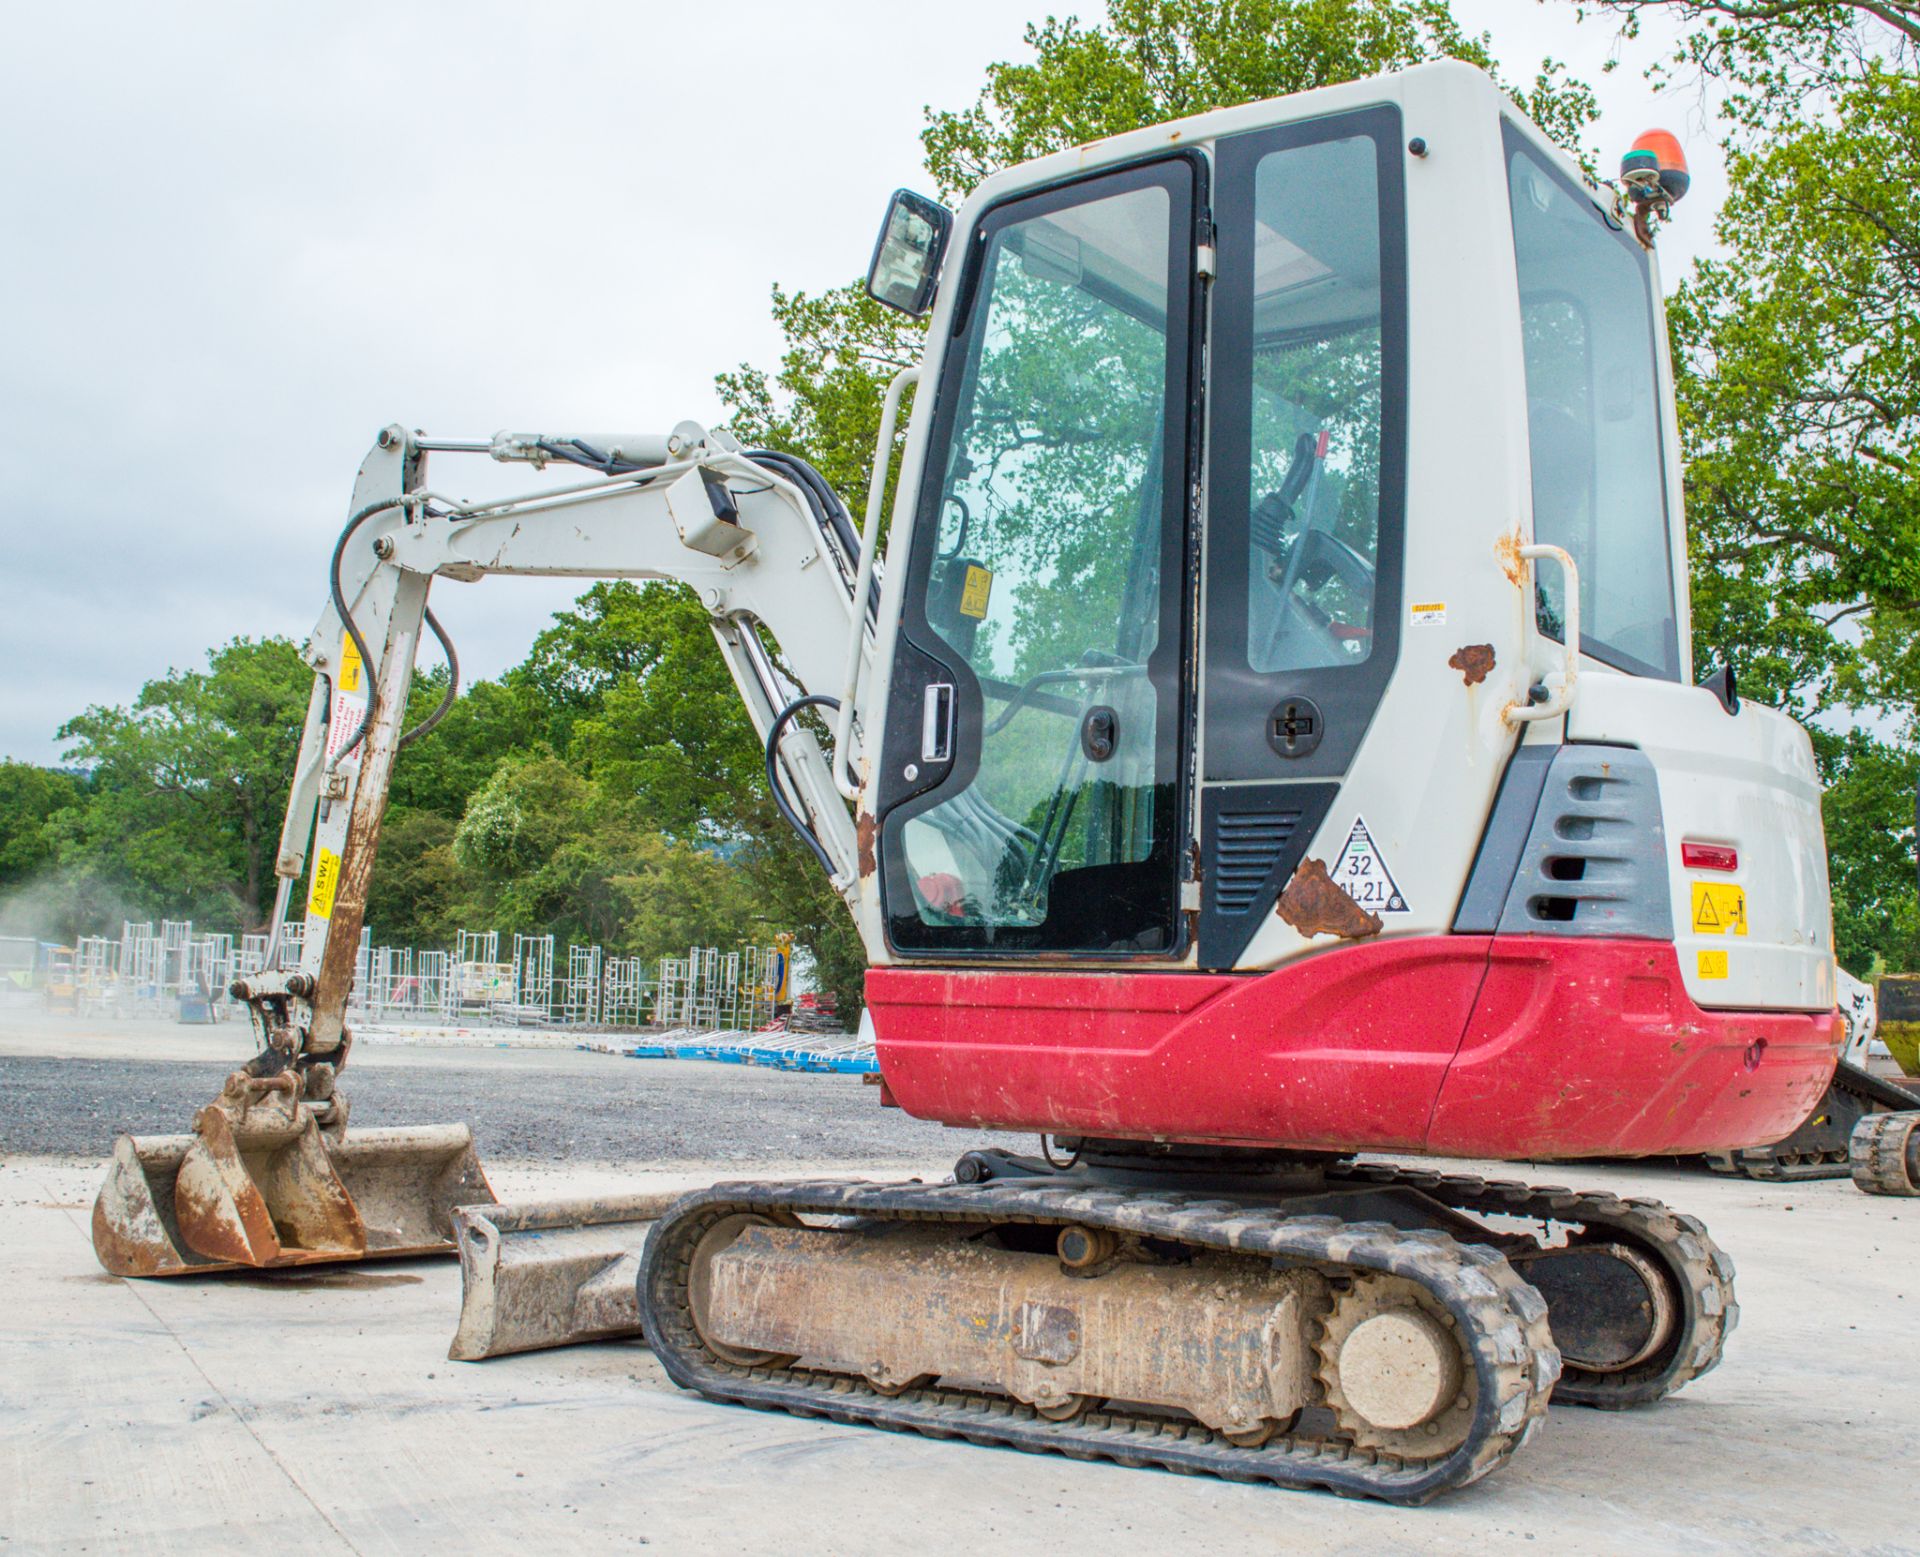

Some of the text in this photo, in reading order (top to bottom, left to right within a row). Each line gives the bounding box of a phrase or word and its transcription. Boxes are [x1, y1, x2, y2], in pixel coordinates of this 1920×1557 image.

[330, 716, 341, 756] Manual
[316, 855, 330, 890] SWL
[1348, 855, 1372, 876] 32
